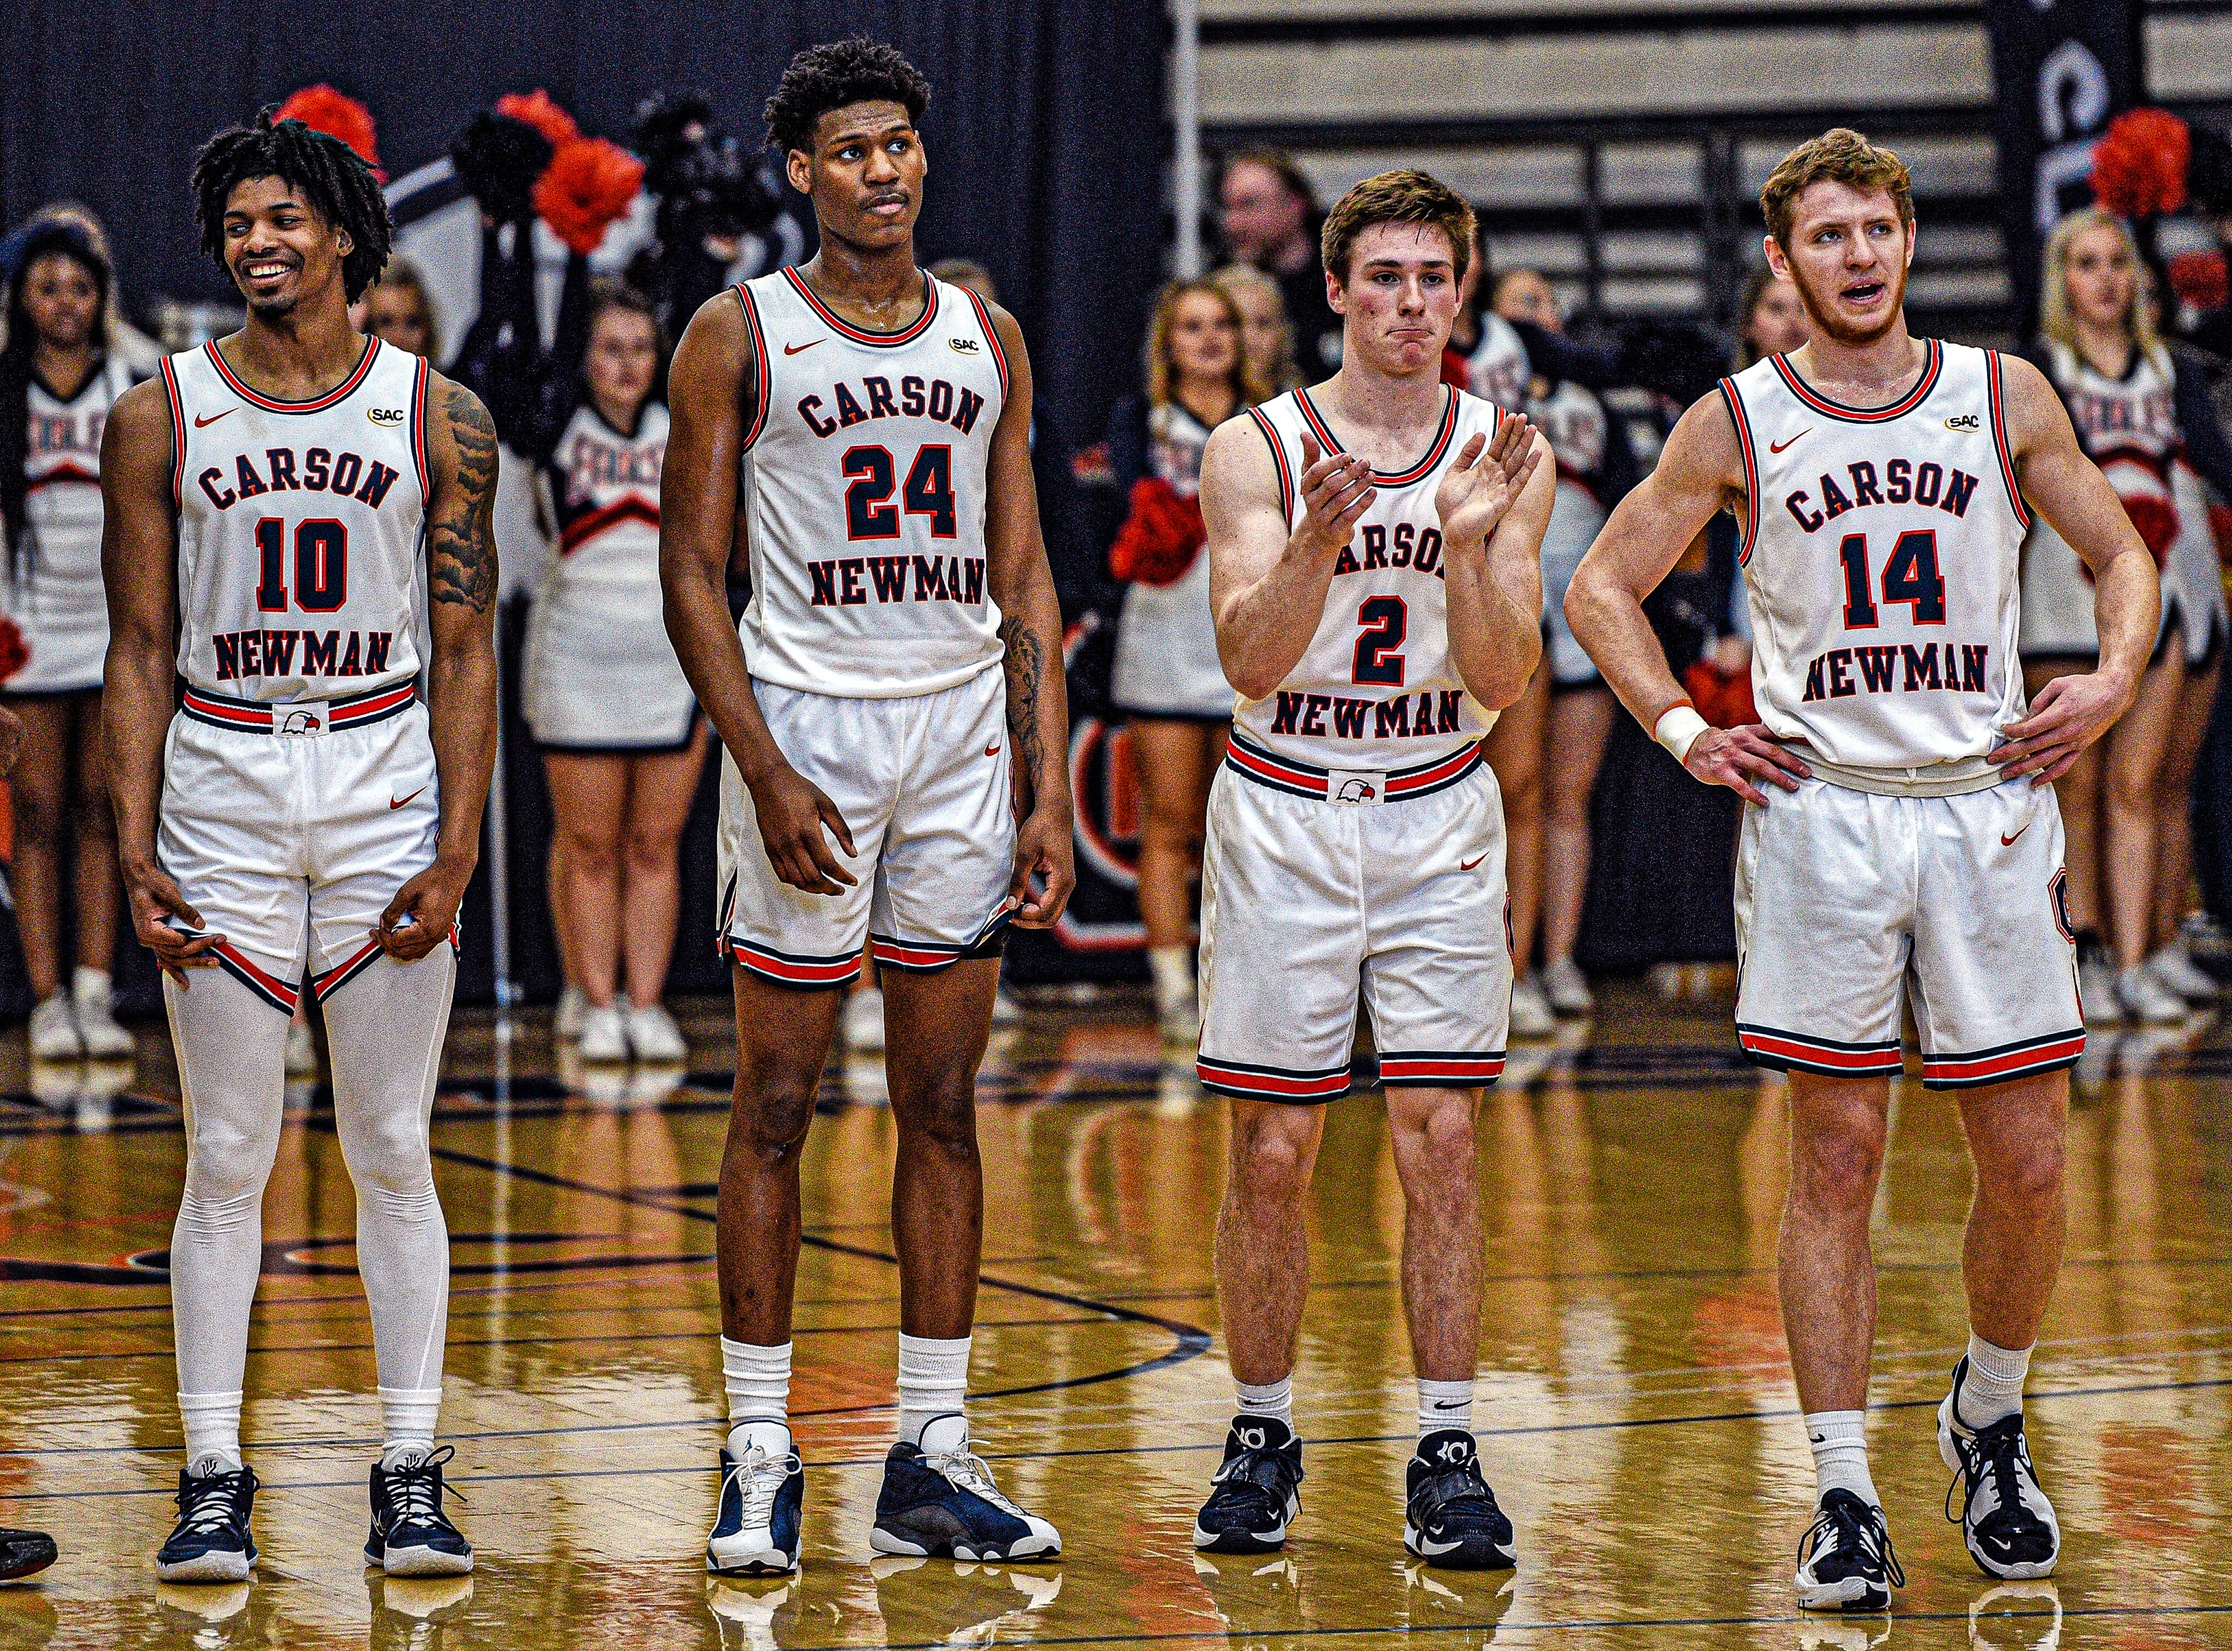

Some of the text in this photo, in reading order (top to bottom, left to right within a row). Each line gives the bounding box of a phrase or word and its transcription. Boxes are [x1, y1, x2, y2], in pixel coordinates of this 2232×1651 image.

[952, 338, 979, 351] SAC
[371, 408, 404, 422] SAC
[797, 375, 985, 439] CARSON
[1950, 415, 1980, 428] SAC
[198, 447, 400, 511] CARSON
[840, 443, 957, 542] 24
[1785, 458, 1980, 534] CARSON
[254, 516, 349, 614] 10
[807, 554, 985, 607] NEWMAN
[1333, 522, 1446, 581] ARSO
[1839, 528, 1946, 631] 14
[212, 629, 393, 681] NEWMAN
[1351, 594, 1408, 688] 2
[1801, 642, 1989, 703] NEWMAN
[1270, 689, 1464, 740] NEWMAN
